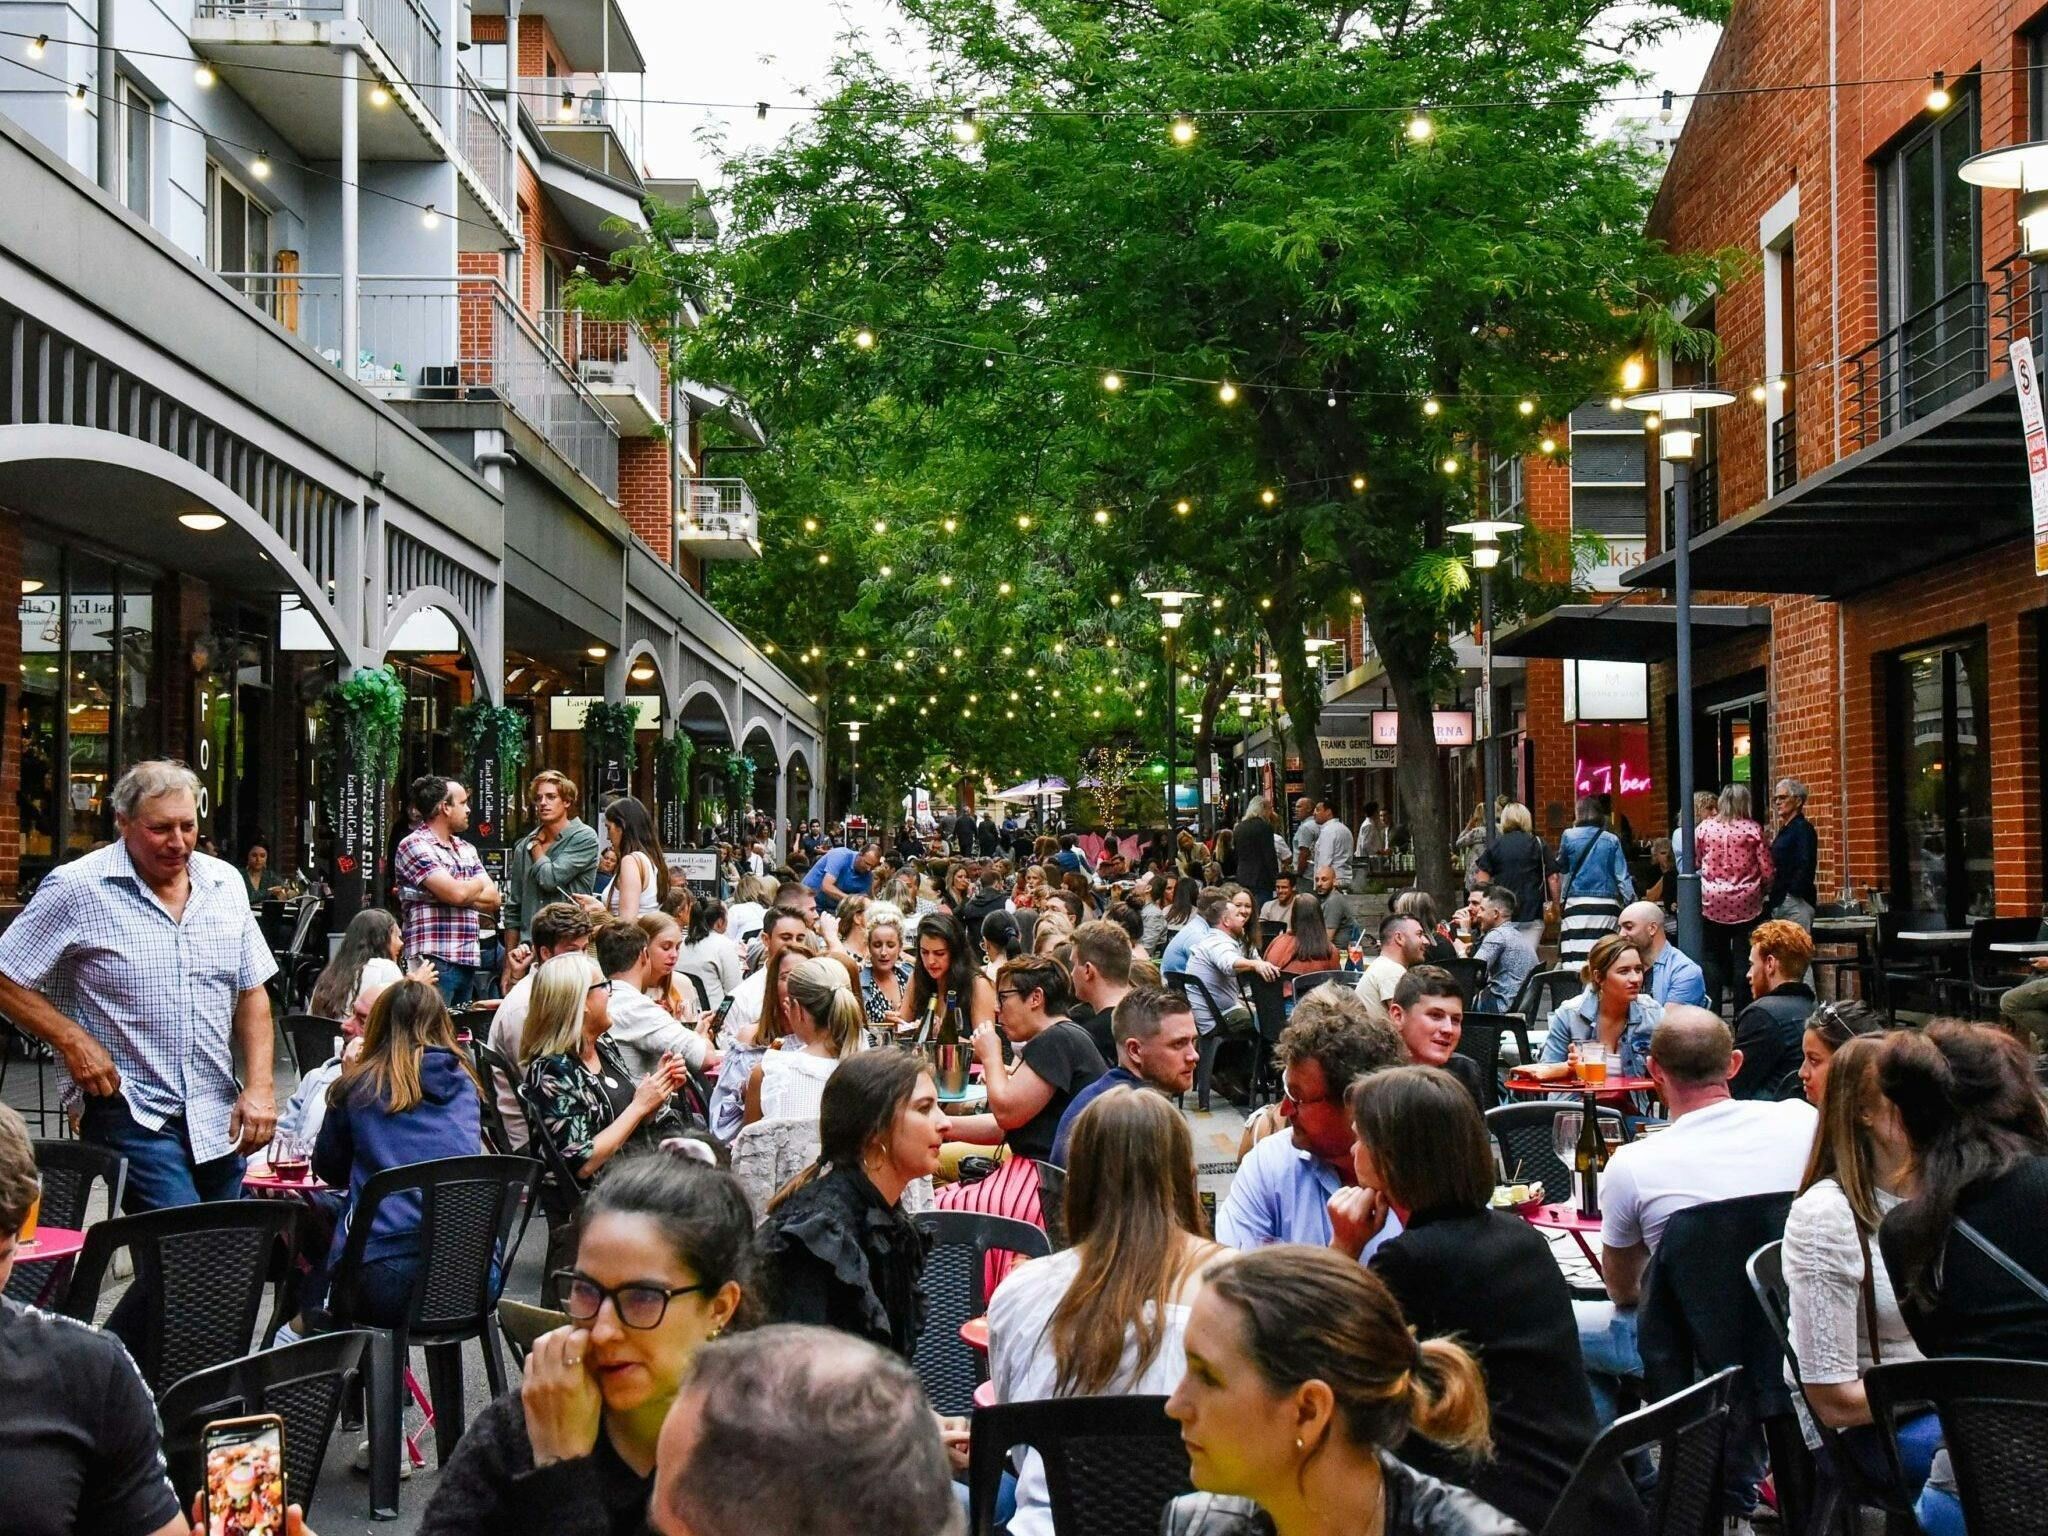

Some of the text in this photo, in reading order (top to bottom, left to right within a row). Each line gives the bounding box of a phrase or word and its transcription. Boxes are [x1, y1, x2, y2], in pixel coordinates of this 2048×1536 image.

[1320, 740, 1347, 749] FRANKS
[1374, 750, 1389, 760] $20
[485, 759, 494, 777] East
[346, 774, 357, 856] East End Cellars
